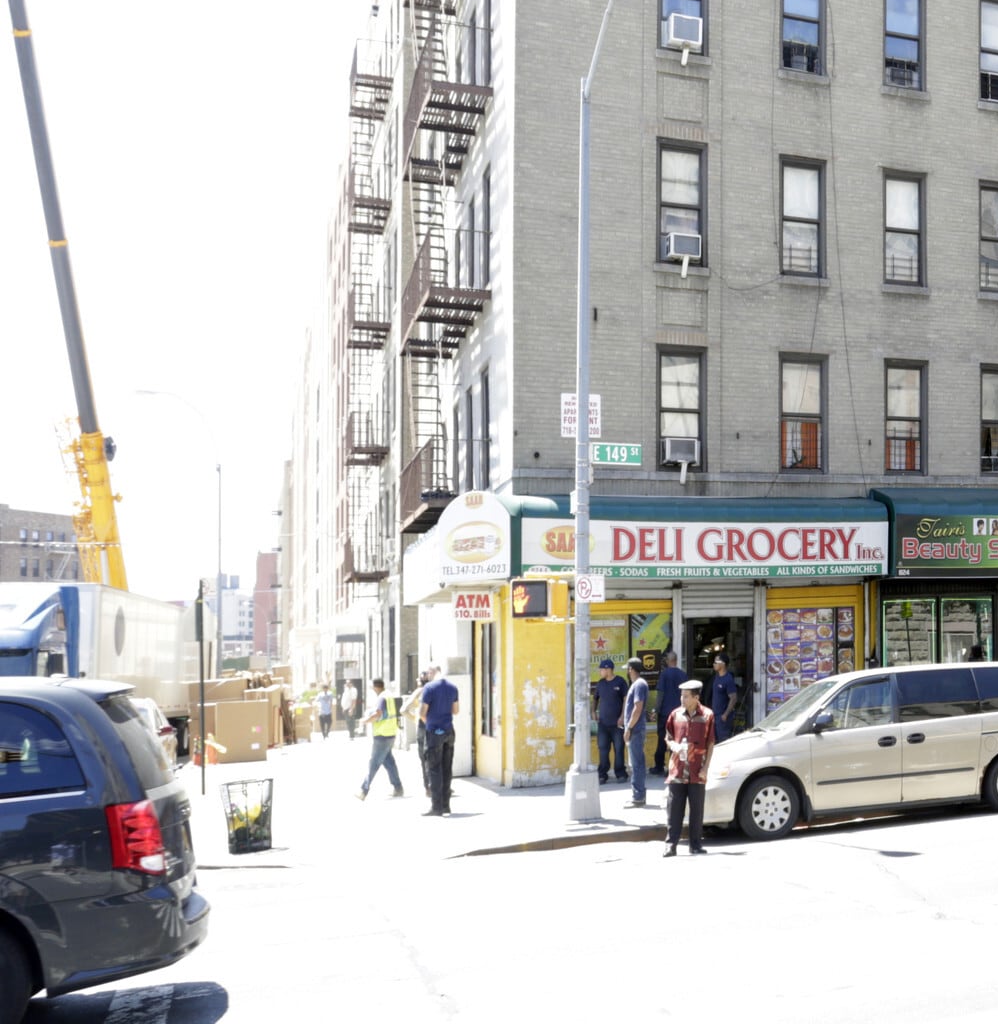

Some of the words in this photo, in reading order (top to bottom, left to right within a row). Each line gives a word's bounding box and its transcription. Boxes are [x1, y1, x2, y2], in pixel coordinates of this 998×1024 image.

[593, 445, 600, 461] E
[605, 446, 628, 462] 149
[545, 531, 575, 552] SAA
[611, 527, 685, 563] DELI
[697, 527, 860, 563] GROCERY
[855, 543, 885, 561] Inc.
[902, 537, 982, 564] Beauty
[619, 567, 649, 576] SODAS
[656, 567, 682, 577] FRESH
[684, 567, 711, 577] FRUITS
[712, 567, 721, 576] &
[723, 566, 770, 576] VEGETABLES
[776, 566, 790, 576] ALL
[791, 564, 816, 576] KINDS
[817, 564, 829, 575] OF
[829, 563, 878, 575] SANDWICHES
[455, 594, 490, 609] ATM
[455, 609, 473, 619] $10.
[474, 609, 491, 619] Bills
